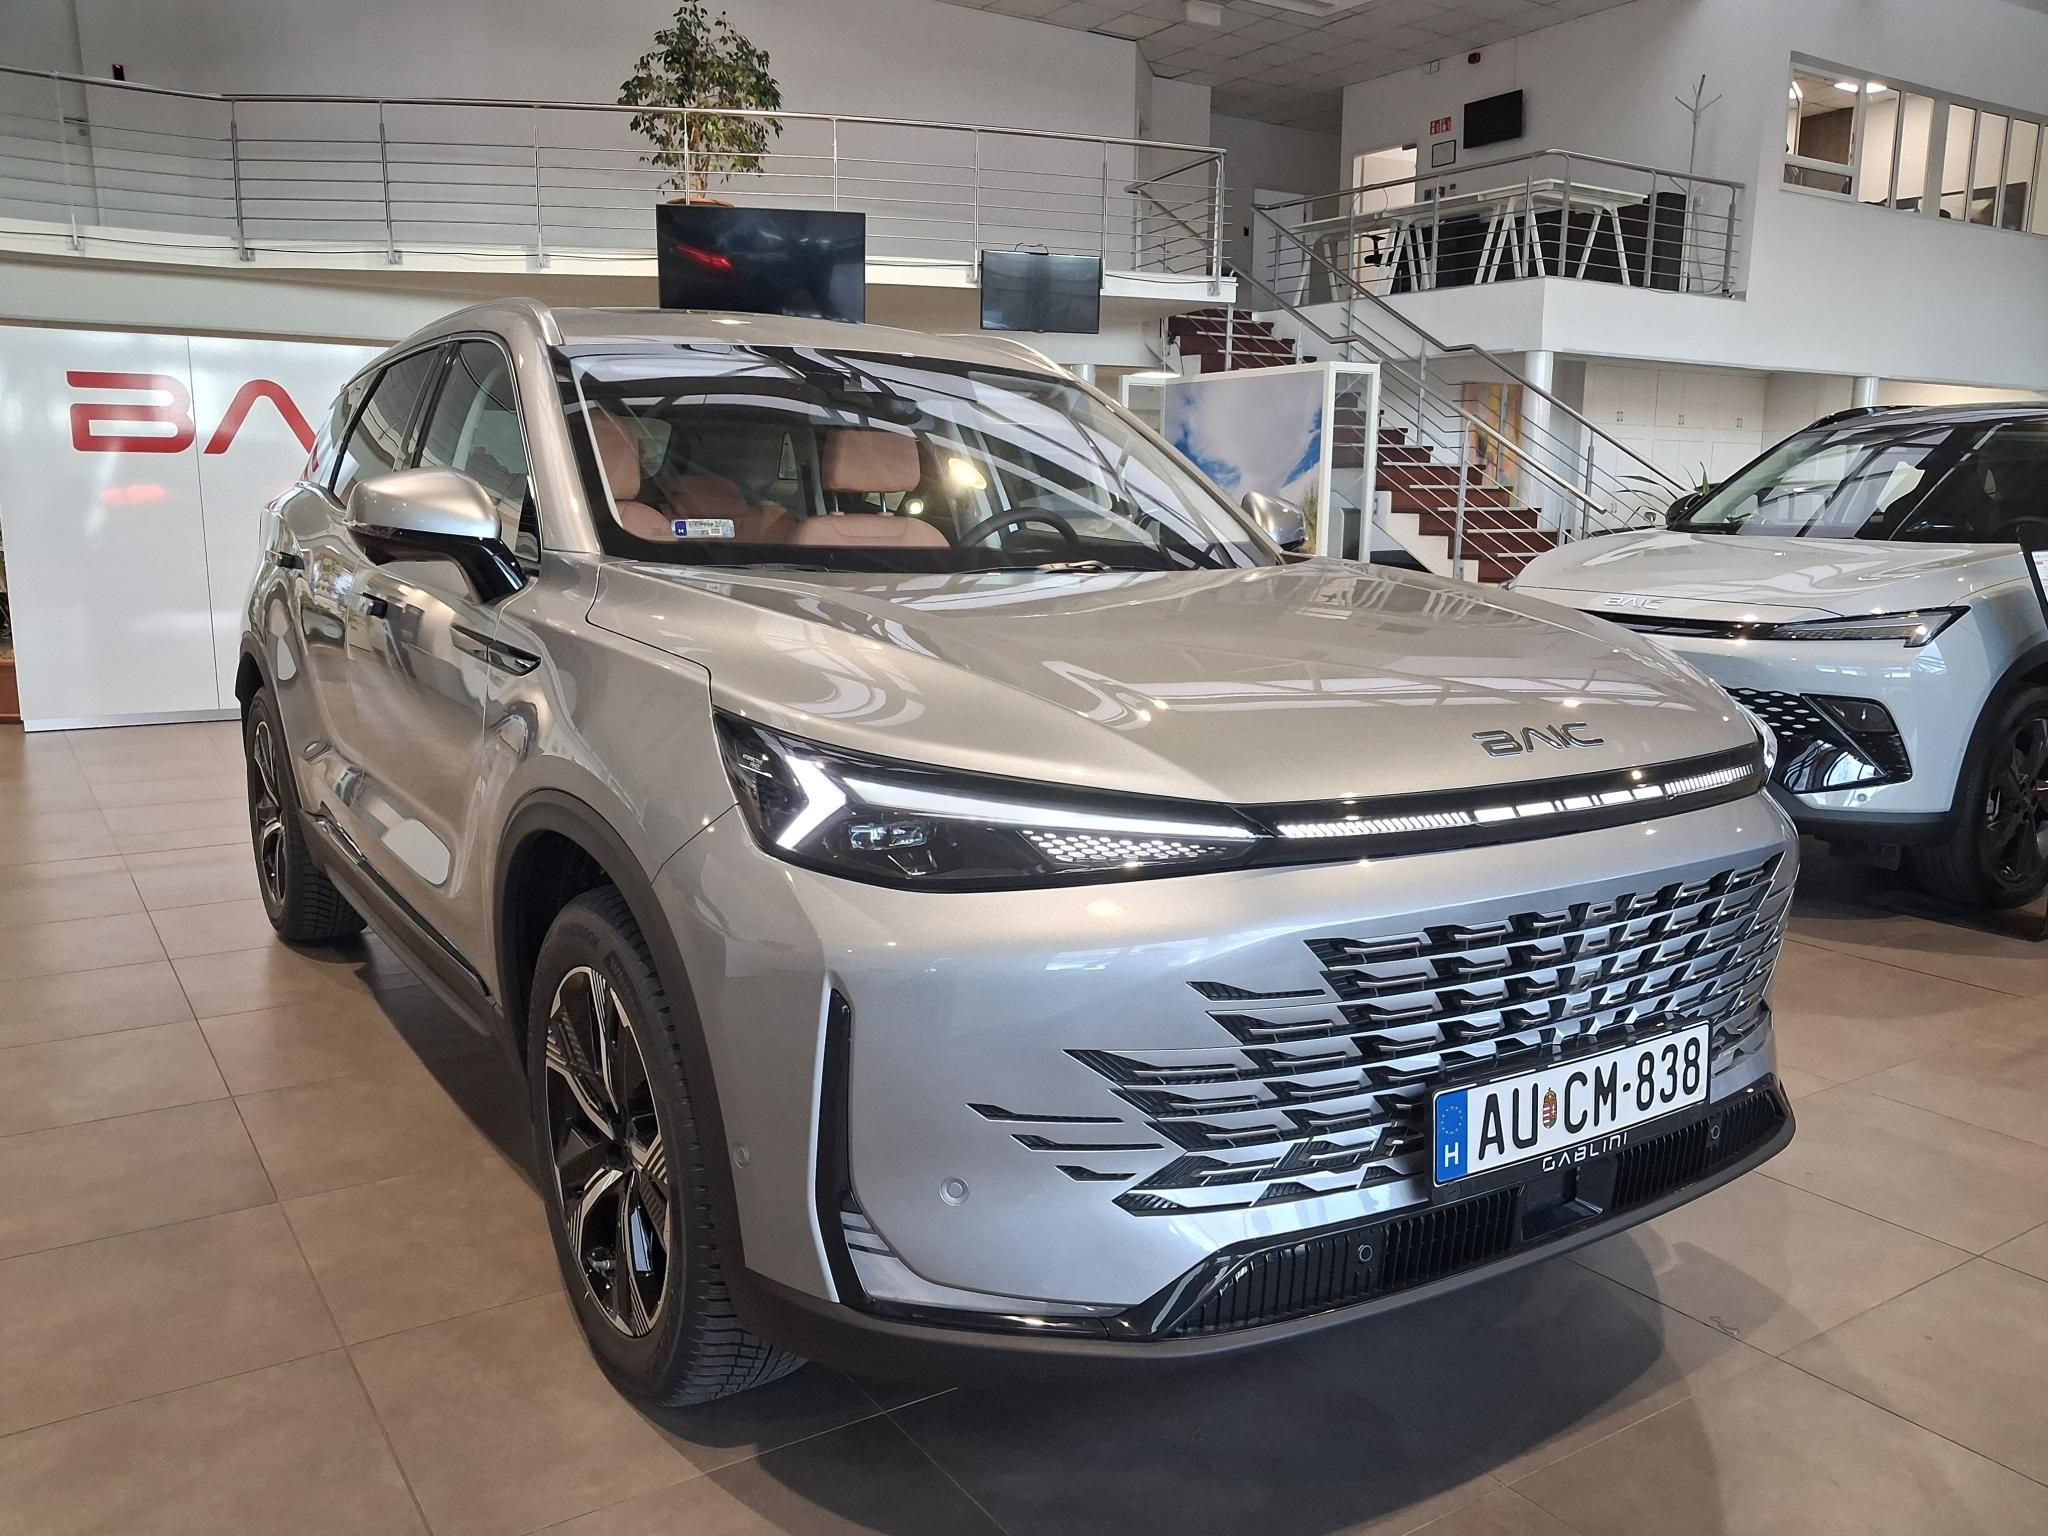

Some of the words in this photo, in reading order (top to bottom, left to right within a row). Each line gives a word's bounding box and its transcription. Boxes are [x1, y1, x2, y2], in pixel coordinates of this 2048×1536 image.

[1603, 596, 1664, 610] BAIC
[1472, 722, 1605, 758] BAIC
[1478, 1082, 1539, 1161] AU
[1563, 1036, 1701, 1135] CM-838
[1444, 1141, 1460, 1168] H
[1541, 1131, 1629, 1173] GABLINI
